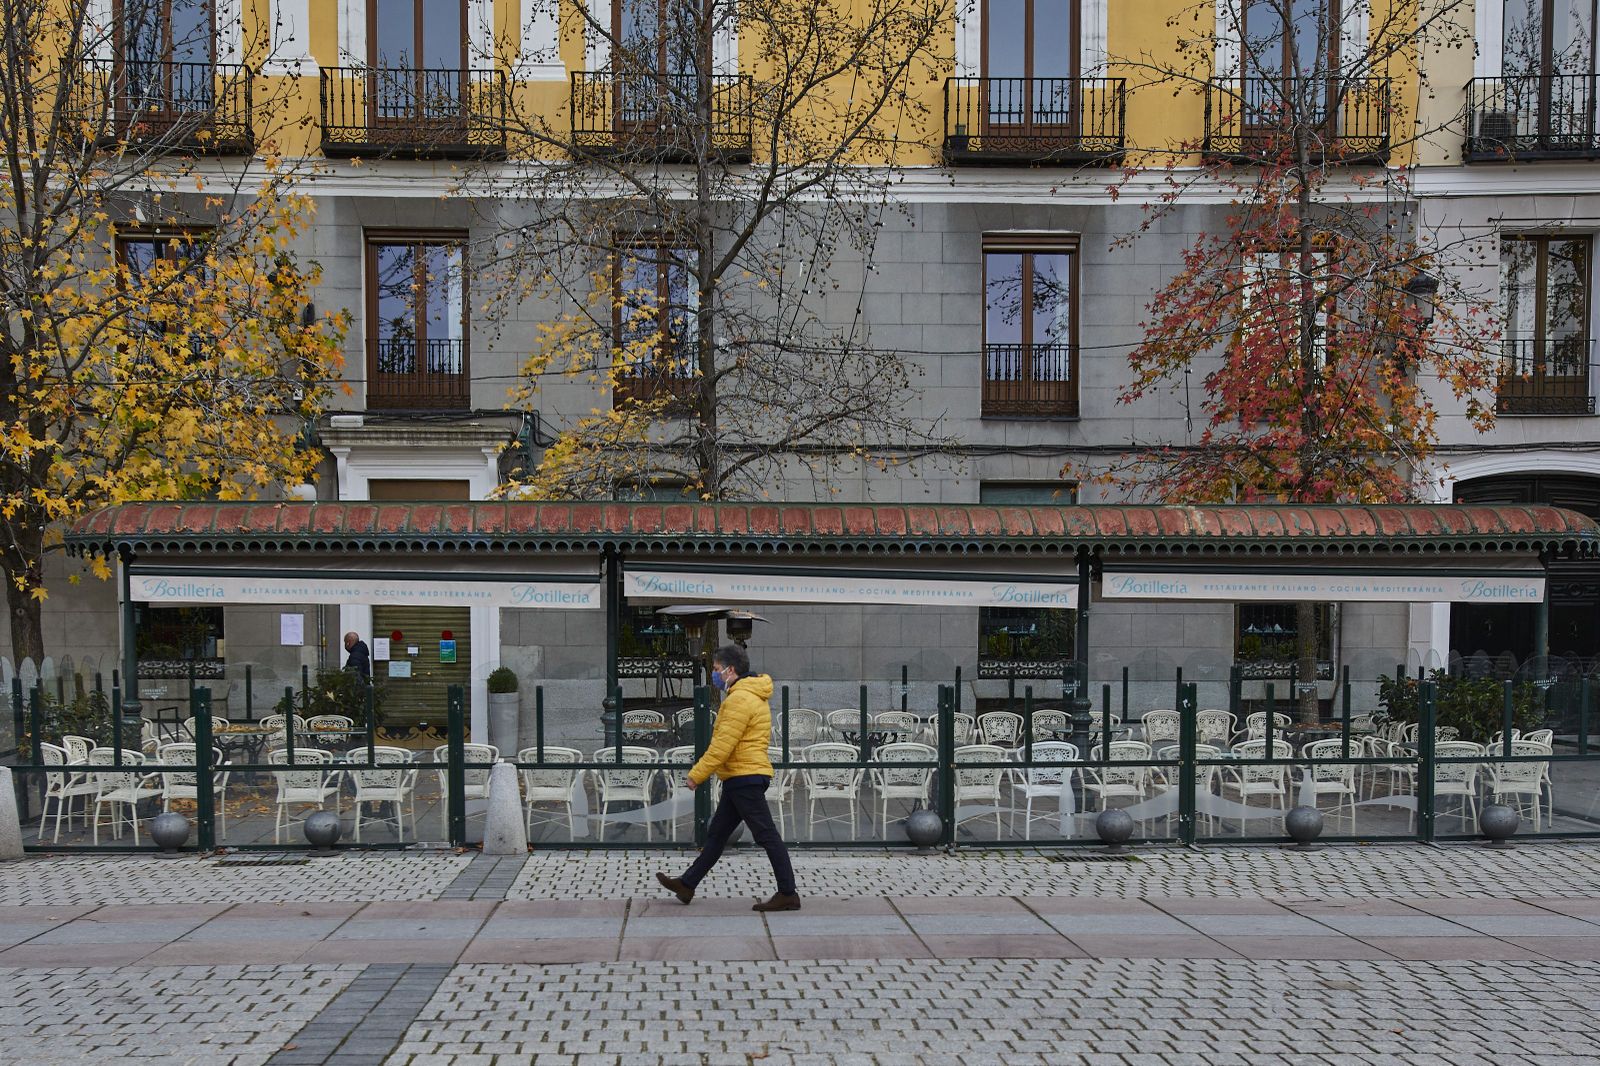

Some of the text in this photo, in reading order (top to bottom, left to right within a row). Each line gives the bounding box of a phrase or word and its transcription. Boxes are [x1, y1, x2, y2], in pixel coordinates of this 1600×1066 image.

[148, 578, 225, 598] Botillería
[241, 587, 309, 595] RESTAURANTE
[313, 588, 361, 596] ITALIANO
[374, 589, 413, 597] COCINA
[419, 588, 493, 598] MEDITERRÁNEA
[514, 583, 590, 604] Botillería
[641, 575, 714, 594] Botillería
[730, 584, 795, 593] RESTAURANTE
[800, 586, 846, 594] ITALIANO
[858, 588, 897, 596] COCINA
[902, 588, 974, 598] MEDITERRÁNEA
[997, 584, 1068, 604] Botillería
[1117, 575, 1188, 595] Botillería
[1203, 584, 1267, 592] RESTAURANTE
[1272, 584, 1317, 592] ITALIANO
[1329, 585, 1368, 593] COCINA
[1373, 584, 1444, 593] MEDITERRÁNEA
[1464, 579, 1537, 599] Botillería
